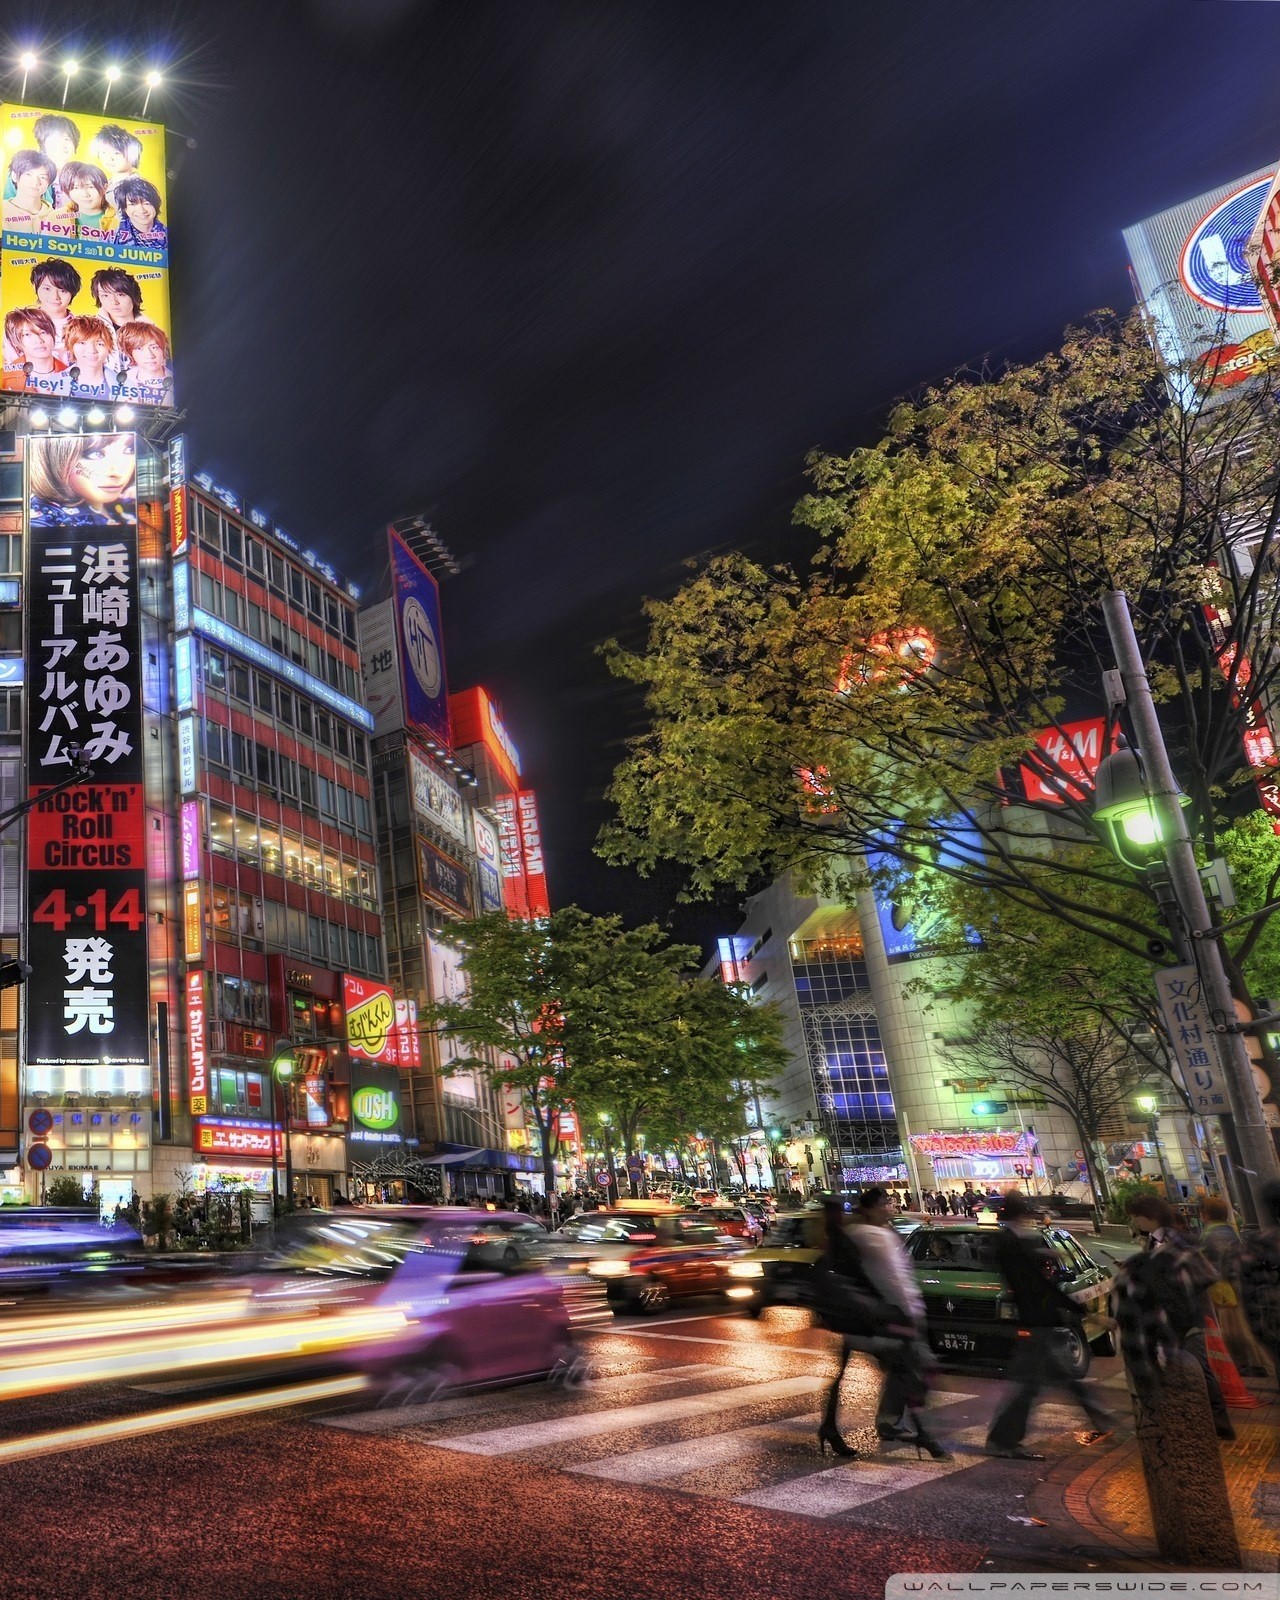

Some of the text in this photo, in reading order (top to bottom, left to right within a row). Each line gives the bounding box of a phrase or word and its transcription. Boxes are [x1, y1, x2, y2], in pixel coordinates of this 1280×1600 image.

[40, 220, 130, 242] Hey! Say! 7
[6, 234, 44, 250] Hey!
[47, 239, 83, 255] Say!
[118, 248, 164, 264] JUMP
[26, 376, 147, 399] Hey! Say! BEST
[38, 548, 79, 767] ニューアルバム
[81, 543, 134, 764] 浜崎あゆみ
[181, 725, 193, 788] 渋谷駅前ビル
[1045, 727, 1098, 764] H&M
[37, 787, 137, 813] Rock'n'
[183, 802, 197, 813] 5F
[63, 814, 113, 840] Roll
[45, 840, 132, 867] Circus
[62, 936, 116, 1036] 発売
[349, 1001, 391, 1040] むじんくん
[1164, 979, 1214, 1091] 文化村通り
[385, 1047, 397, 1063] 3F
[193, 1097, 206, 1113] 薬
[357, 1091, 394, 1121] LUSH
[1196, 1093, 1225, 1107] 方面
[229, 1132, 271, 1150] サンドラッグ
[944, 1338, 976, 1351] 84-77
